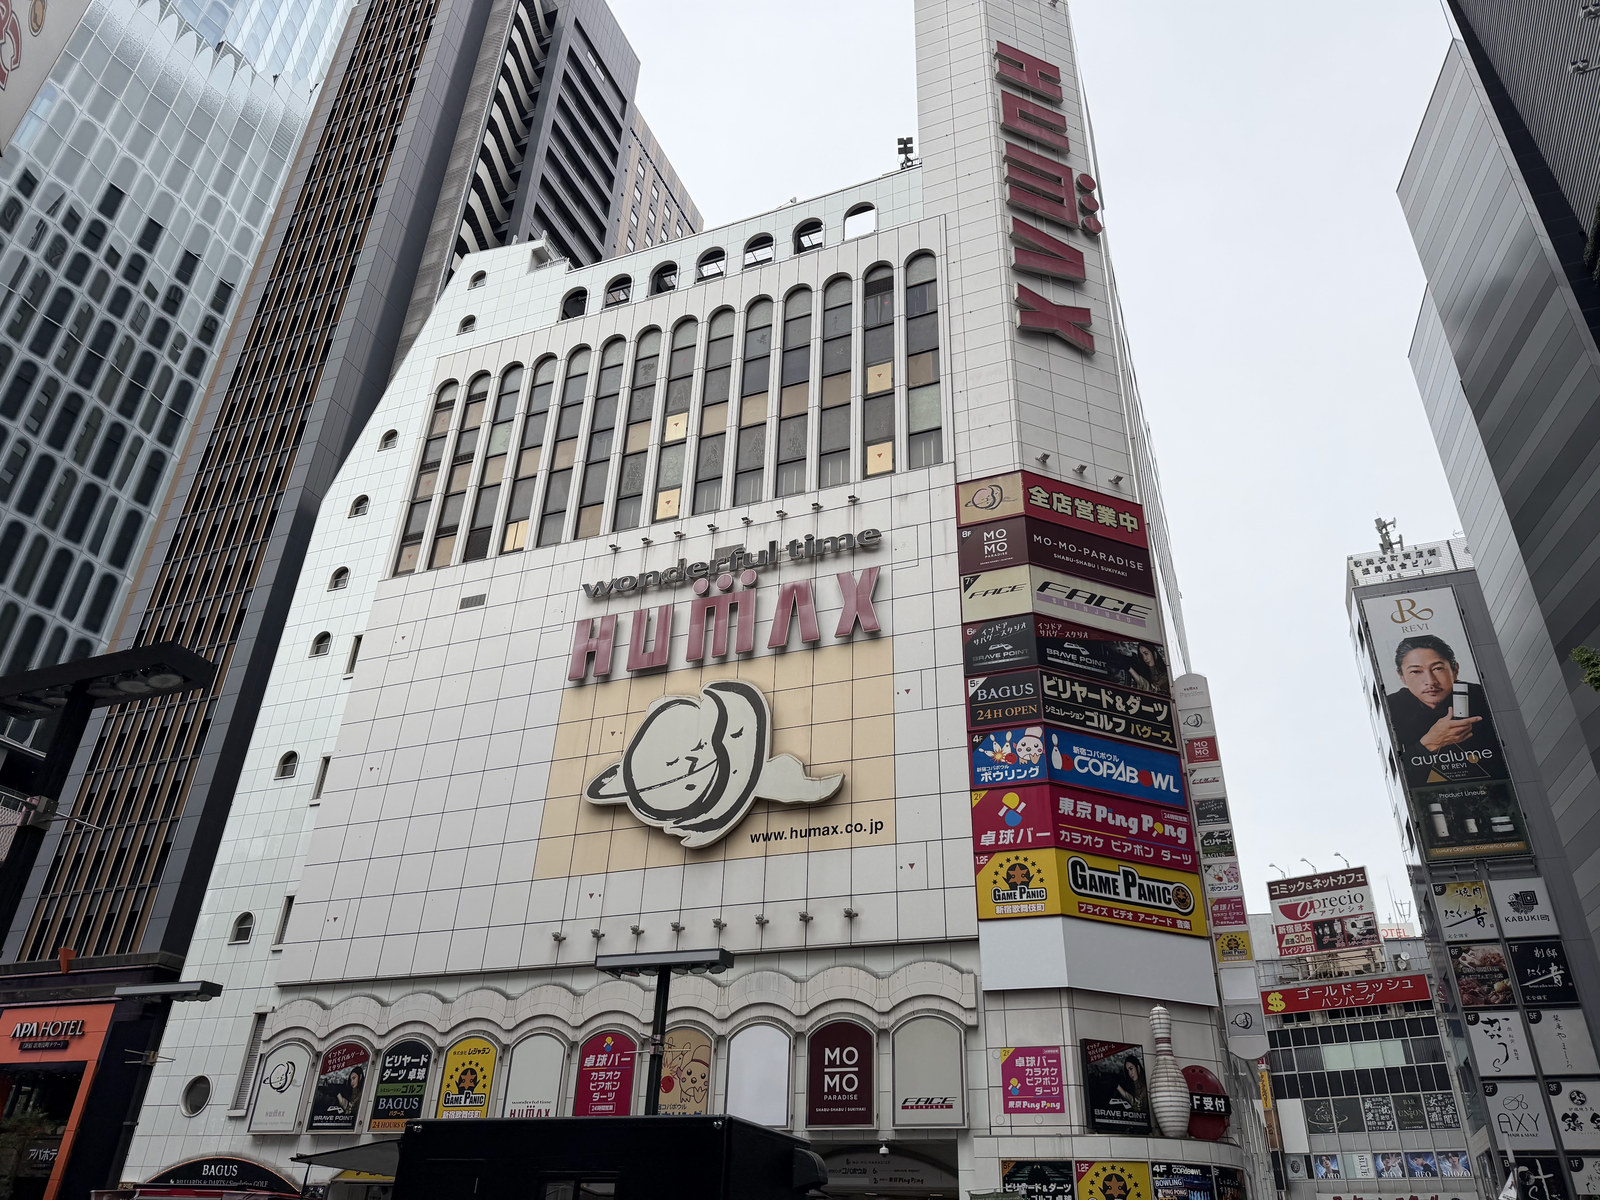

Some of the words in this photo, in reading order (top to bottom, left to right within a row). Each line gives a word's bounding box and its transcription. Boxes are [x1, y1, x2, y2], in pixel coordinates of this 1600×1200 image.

[1028, 485, 1139, 533] 全店営業中
[962, 530, 972, 538] 8F
[984, 528, 1007, 541] MO
[984, 542, 1008, 555] MO
[1033, 534, 1144, 571] MO-MO-PARADISE
[582, 539, 779, 599] wonderful
[785, 527, 883, 560] time
[969, 582, 1027, 599] FACE
[1036, 581, 1152, 619] FACE
[567, 566, 881, 681] HUMAX
[982, 621, 1008, 635] インドア
[1038, 622, 1062, 631] インドア
[1401, 623, 1430, 634] REVI
[1046, 648, 1077, 661] BRAVE
[1080, 656, 1108, 668] POINT
[977, 683, 1034, 700] BAGUS
[1042, 674, 1169, 722] ビリヤード&ダーツ
[1005, 704, 1037, 717] OPEN
[1411, 748, 1493, 766] auralume
[981, 766, 1039, 782] ボウリング
[1058, 797, 1092, 820] 東京
[1095, 804, 1139, 835] Ping
[750, 818, 884, 844] www.humax.co.jp
[980, 827, 1051, 846] 卓球バー
[1059, 830, 1104, 848] カラオケ
[1161, 849, 1192, 865] ダーツ
[1070, 858, 1120, 897] GAME
[1122, 867, 1172, 905] PANIC
[1271, 873, 1365, 895] コミック&ネットカフェ
[993, 887, 1018, 902] GAME
[1019, 886, 1045, 901] PANIC
[995, 903, 1045, 914] 新宿歌舞伎町
[1296, 890, 1364, 918] aprecio
[1079, 903, 1108, 916] プライズ
[1112, 909, 1133, 920] ビデオ
[1138, 913, 1172, 926] アーケード
[1297, 979, 1414, 1000] ゴールドラッシュ
[1322, 993, 1376, 1008] ハンバーグ
[10, 1022, 38, 1038] APA
[39, 1020, 84, 1037] HOTEL
[385, 1054, 429, 1067] ビリヤード
[584, 1054, 631, 1067] 卓球バー
[824, 1046, 859, 1065] MO
[1015, 1056, 1057, 1067] 卓球バー
[383, 1068, 407, 1080] ダーツ
[408, 1068, 427, 1080] 卓球
[591, 1071, 621, 1080] カラオケ
[1025, 1068, 1058, 1076] カラオケ
[824, 1073, 859, 1092] MO
[444, 1092, 463, 1105] GAME
[464, 1091, 484, 1104] PANIC
[592, 1092, 615, 1101] ダーツ
[1035, 1087, 1060, 1095] ダーツ
[378, 1097, 419, 1110] BAGUS
[902, 1097, 957, 1105] FACE
[1023, 1101, 1040, 1110] Ping
[1190, 1095, 1226, 1112] F受付
[1094, 1108, 1121, 1117] BRAVE
[1123, 1111, 1147, 1119] POINT
[1497, 1113, 1540, 1134] AXY
[29, 1148, 58, 1161] アパホテ
[202, 1164, 238, 1176] BAGUS
[1153, 1165, 1167, 1173] 4F
[1155, 1179, 1182, 1187] BOWLING
